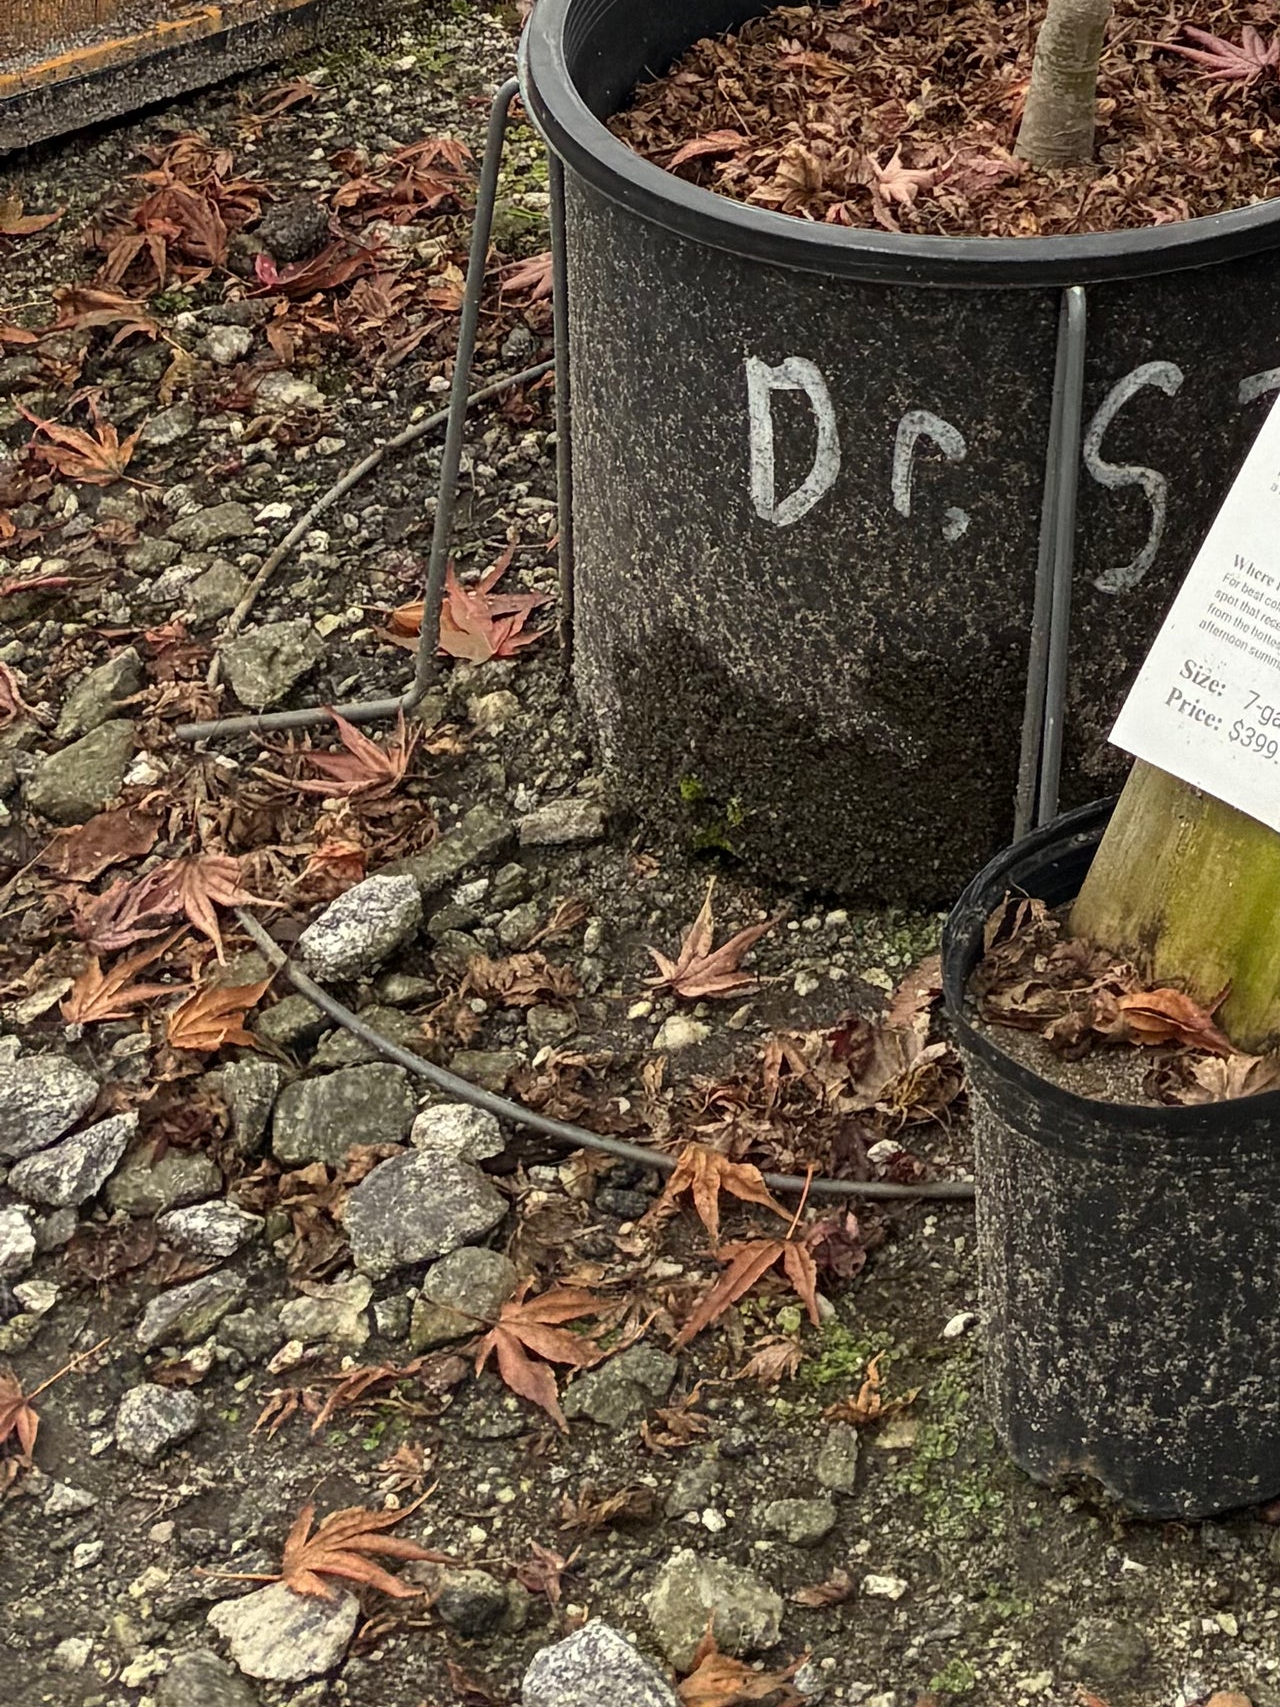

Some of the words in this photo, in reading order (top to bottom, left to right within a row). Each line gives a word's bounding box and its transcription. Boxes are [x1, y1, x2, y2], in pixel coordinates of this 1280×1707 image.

[745, 354, 971, 541] Dr.
[1269, 482, 1279, 493] a
[1233, 554, 1275, 587] Where
[1221, 572, 1242, 589] For
[1240, 581, 1265, 603] best
[1207, 602, 1233, 623] from
[1232, 616, 1251, 634] the
[1214, 589, 1240, 608] spot
[1239, 600, 1261, 620] that
[1198, 619, 1249, 652] afternoon
[1179, 659, 1226, 697] Size:
[1164, 686, 1223, 732] Price:
